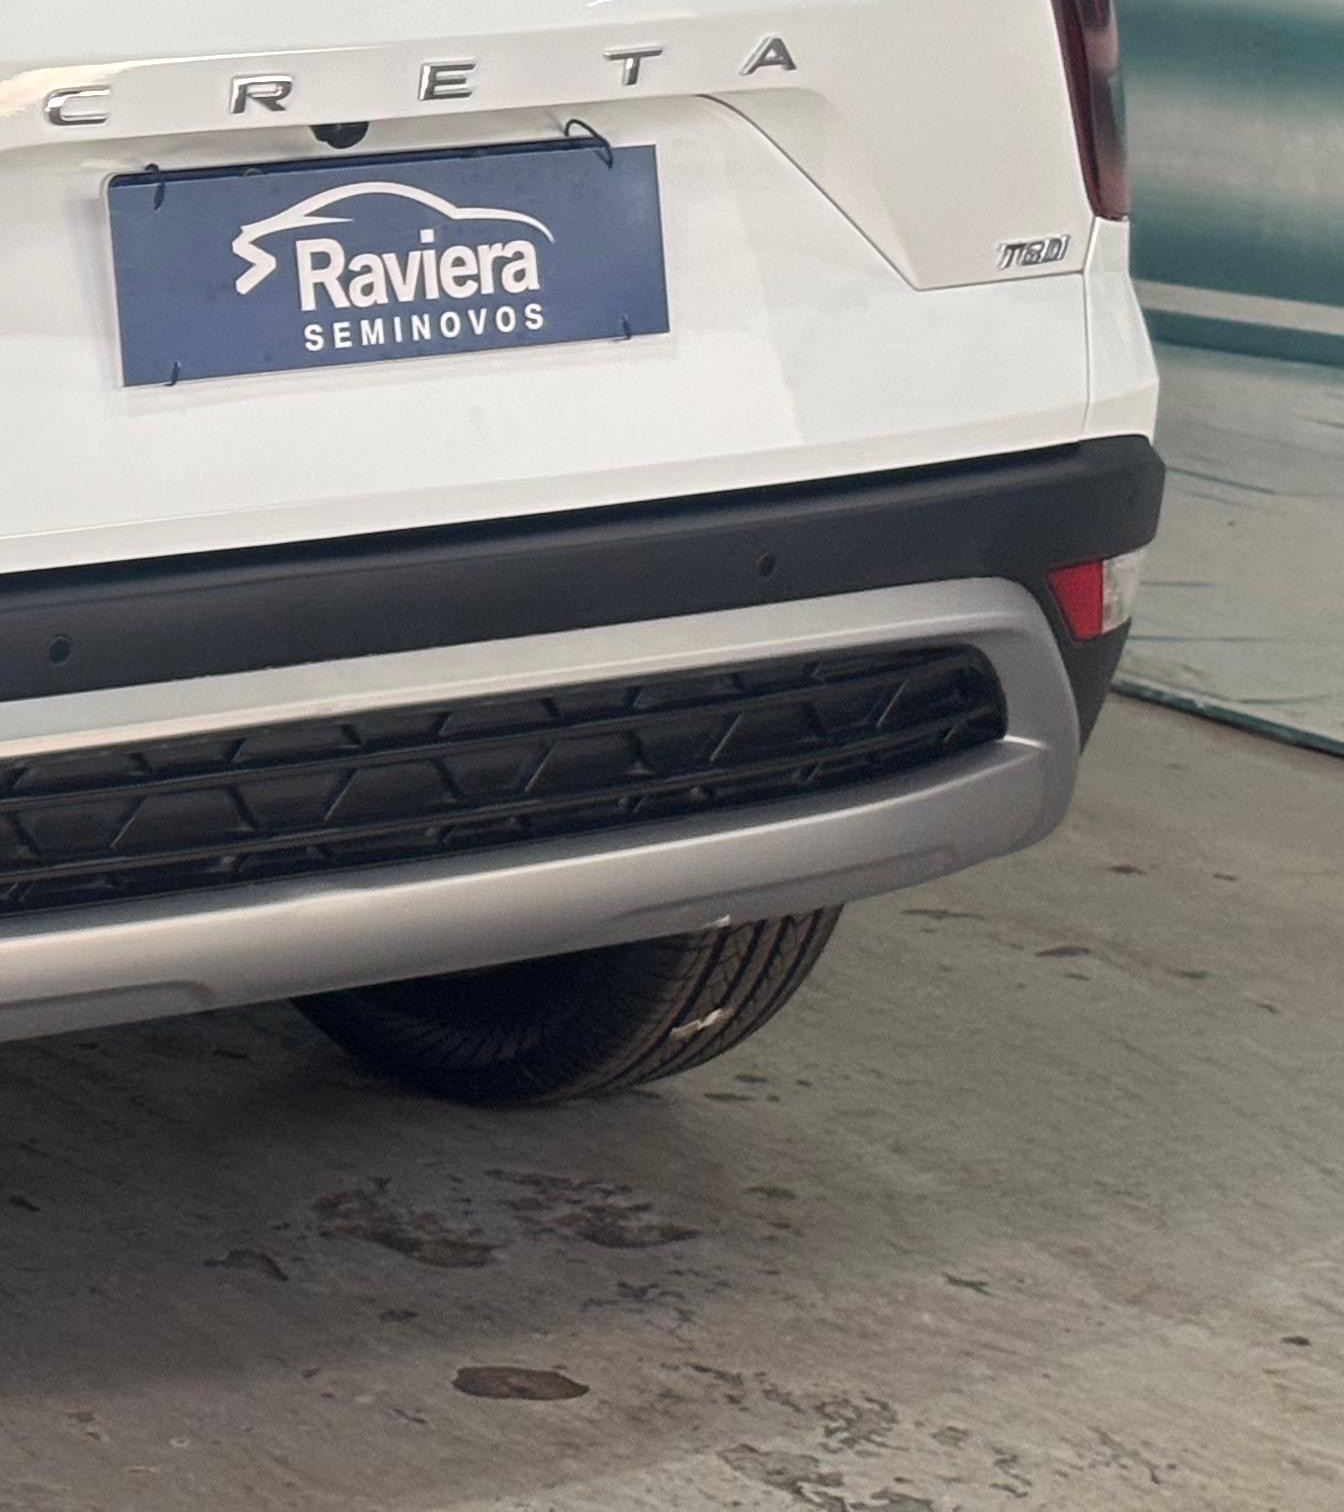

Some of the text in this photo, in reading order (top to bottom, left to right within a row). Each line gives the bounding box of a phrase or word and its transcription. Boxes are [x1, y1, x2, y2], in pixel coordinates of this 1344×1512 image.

[43, 35, 798, 127] CRETA
[295, 227, 540, 312] Raviera
[303, 302, 546, 352] SEMINOVOS
